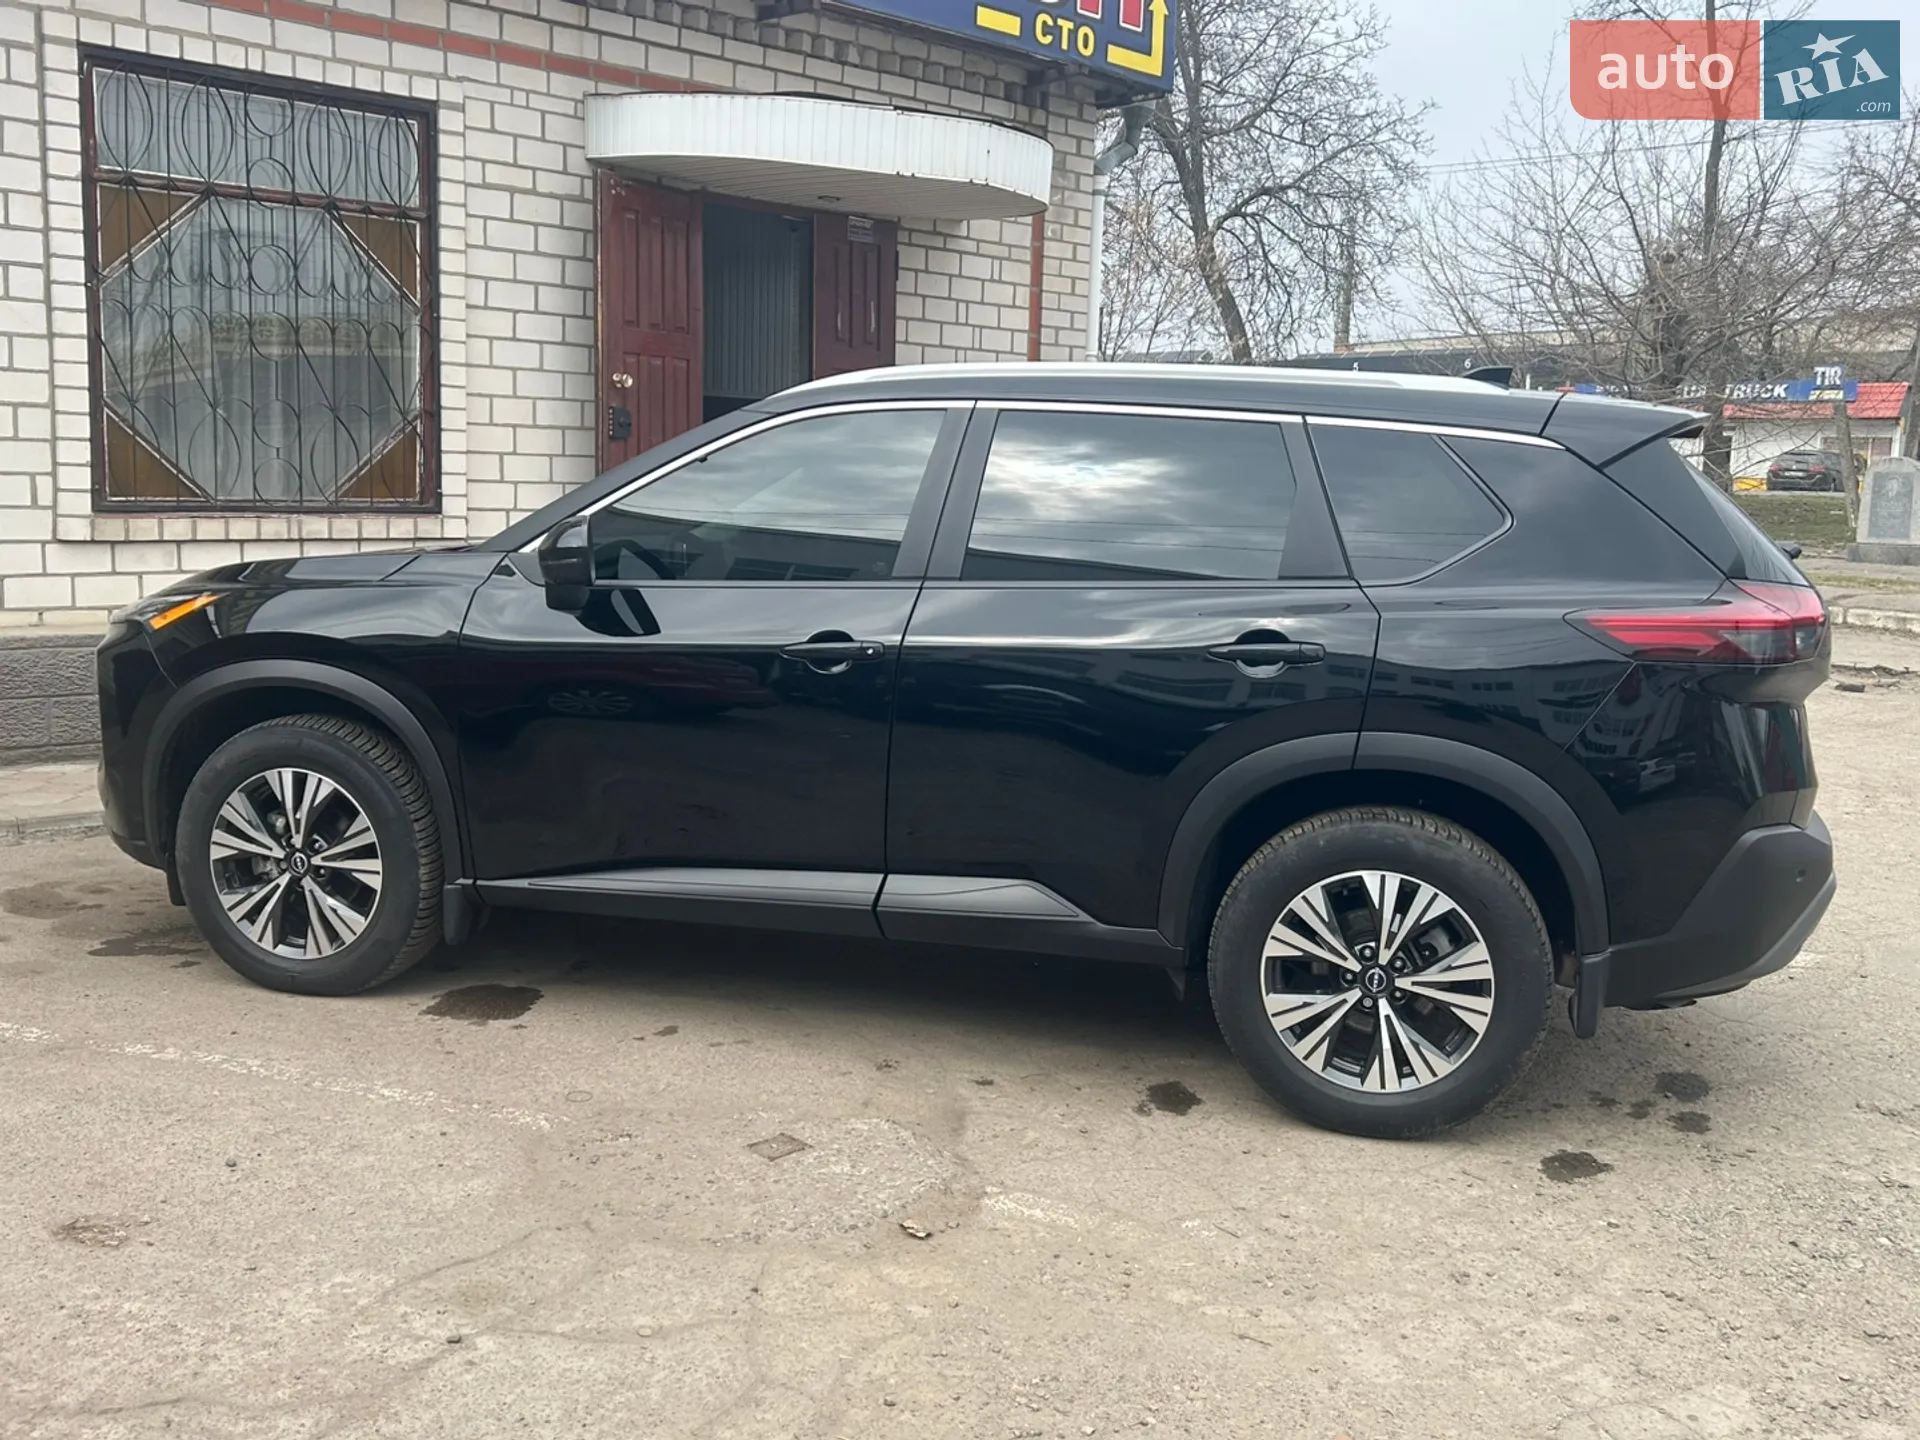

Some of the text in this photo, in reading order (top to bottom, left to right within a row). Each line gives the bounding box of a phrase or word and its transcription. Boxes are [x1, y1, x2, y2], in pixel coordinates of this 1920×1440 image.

[1034, 12, 1095, 57] СТО
[1464, 358, 1472, 369] 6
[1813, 366, 1842, 386] TIR
